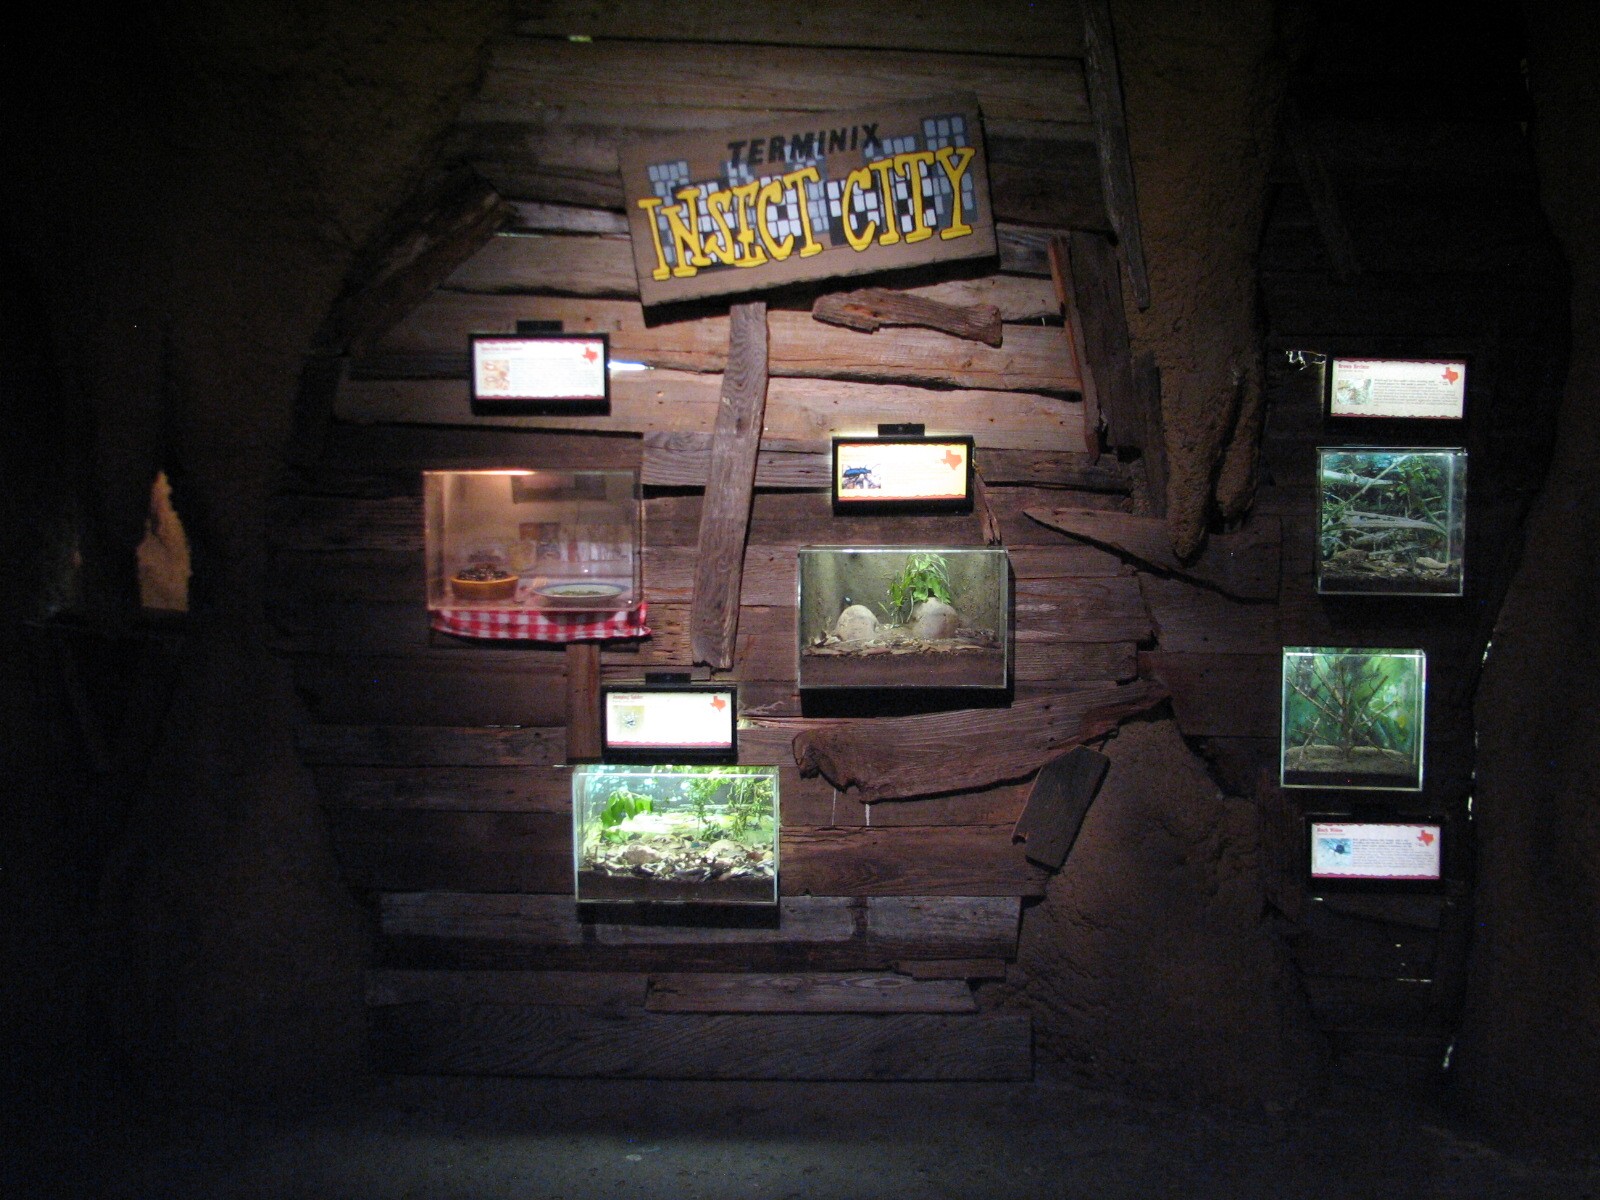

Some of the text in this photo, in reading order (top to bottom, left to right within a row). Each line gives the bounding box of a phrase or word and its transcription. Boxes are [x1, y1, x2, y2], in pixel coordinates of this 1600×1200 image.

[727, 122, 882, 168] TERMINIX
[638, 145, 976, 281] INSECT CITY
